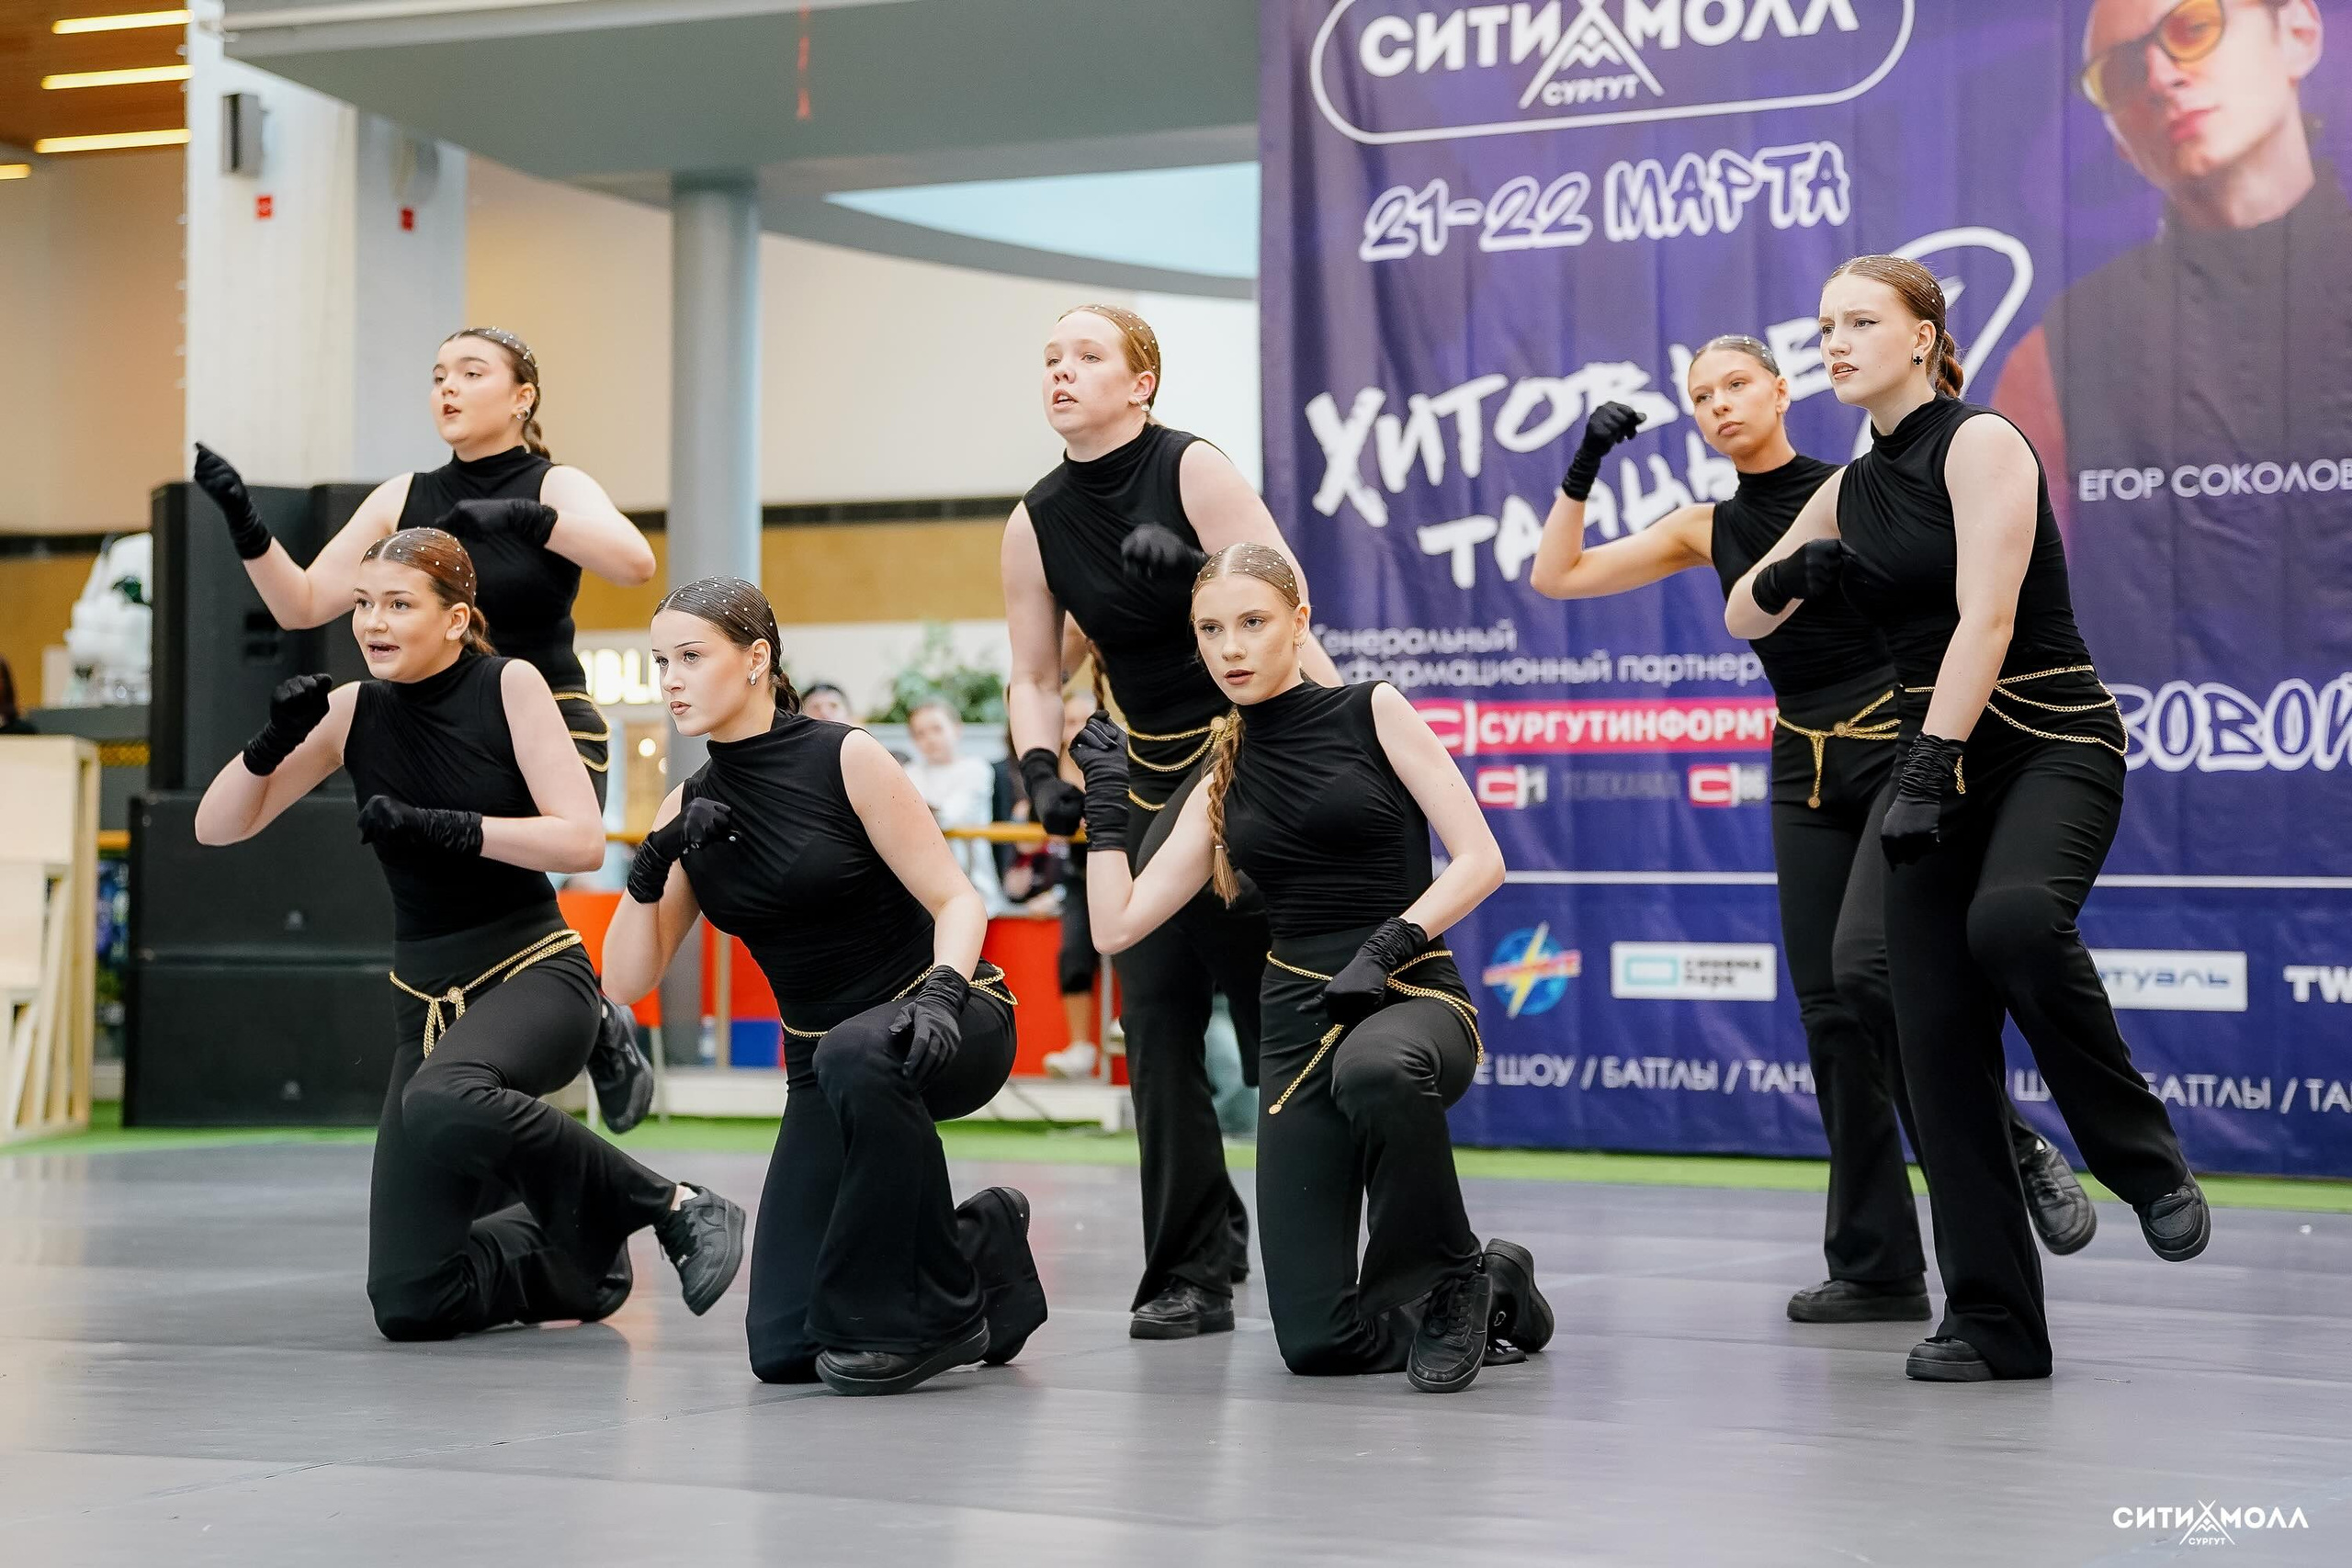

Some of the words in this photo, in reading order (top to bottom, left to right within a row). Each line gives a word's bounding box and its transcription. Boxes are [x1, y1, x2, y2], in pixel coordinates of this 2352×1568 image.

[1360, 2, 1562, 77] СИТИ
[1542, 74, 1640, 107] СУРГУТ
[1359, 171, 1593, 262] 21-22
[1604, 141, 1850, 242] МАРТА
[2078, 467, 2165, 502] ЕГОР
[1495, 1053, 1577, 1088] ШОУ
[1600, 1055, 1719, 1092] БАТТЛЫ
